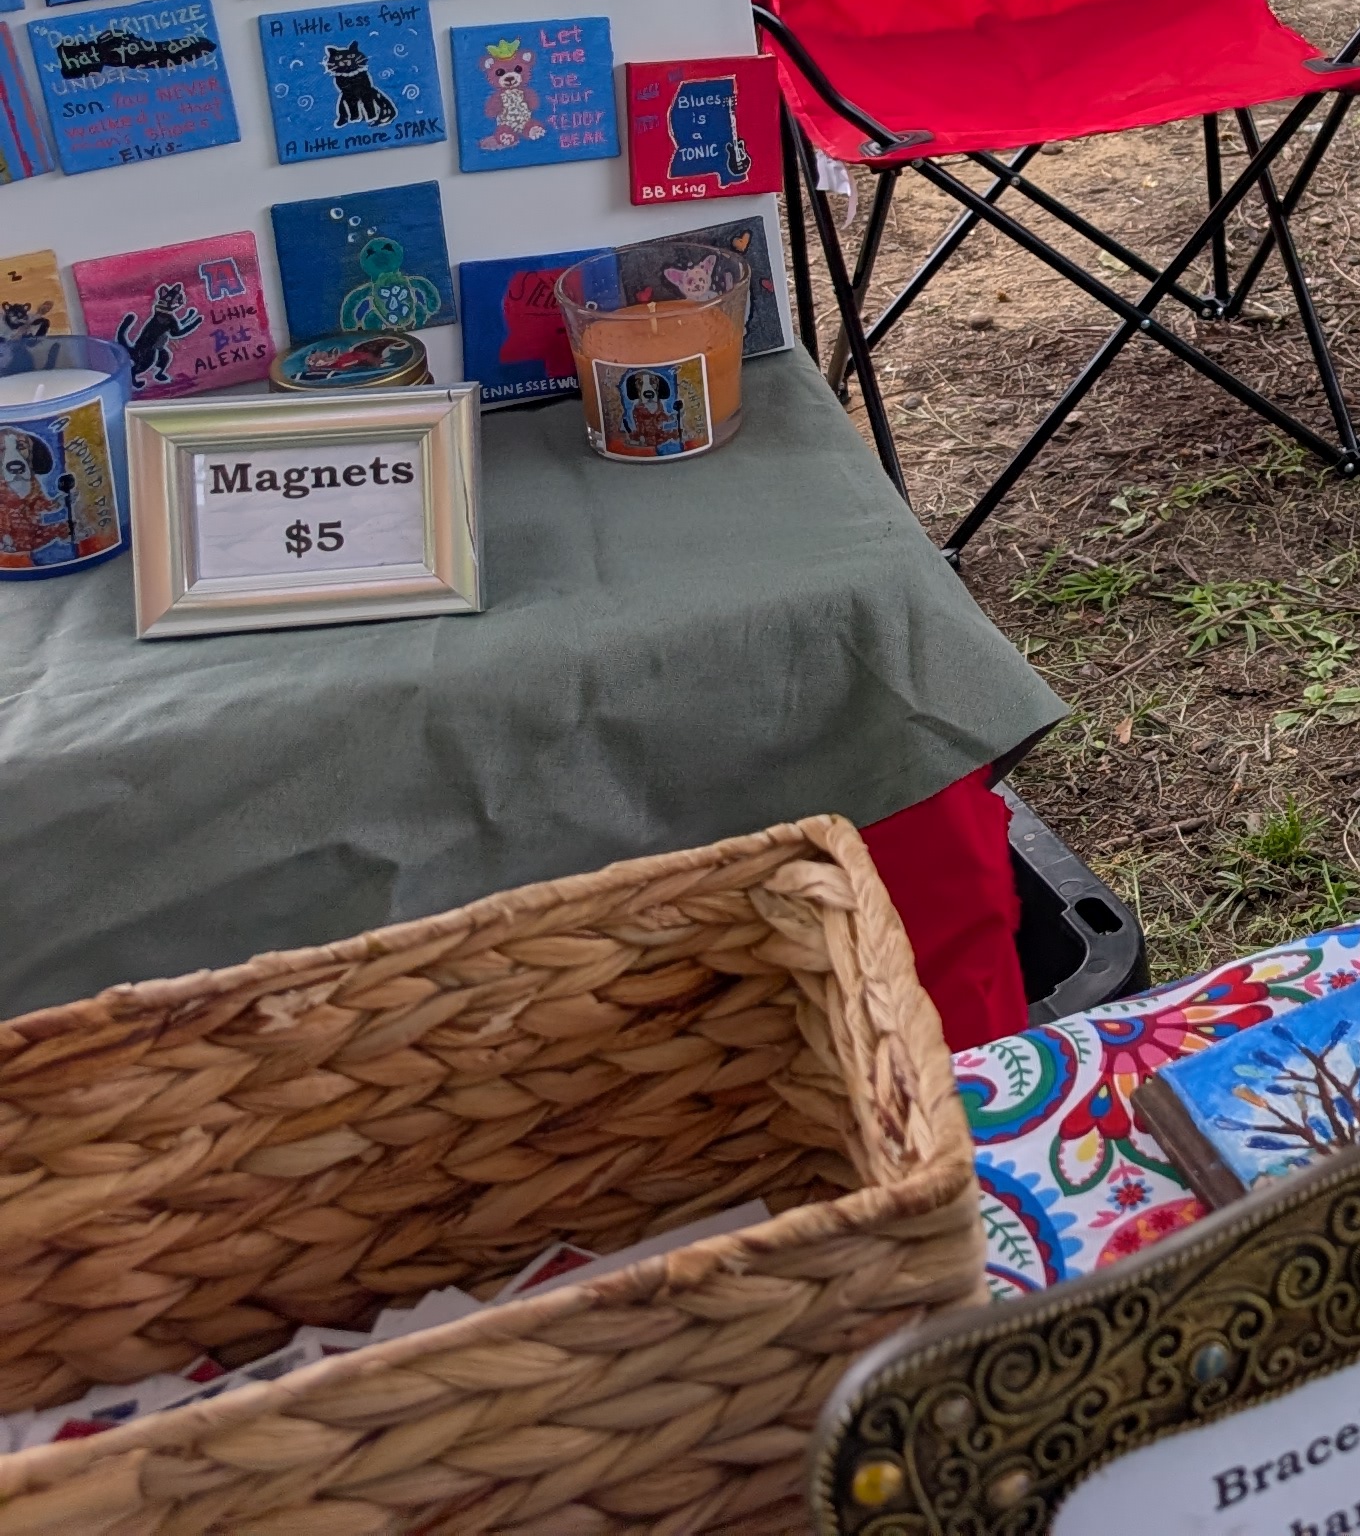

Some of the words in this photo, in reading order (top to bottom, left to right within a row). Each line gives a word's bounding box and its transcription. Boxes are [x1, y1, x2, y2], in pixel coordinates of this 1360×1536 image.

[270, 20, 283, 37] A
[293, 18, 332, 35] little
[339, 13, 371, 31] less
[378, 5, 421, 25] fight
[540, 25, 583, 48] Let
[112, 37, 158, 63] you
[551, 48, 586, 64] me
[157, 77, 223, 101] NEVER
[549, 73, 582, 88] be
[545, 89, 594, 113] your
[678, 95, 721, 109] Blues
[692, 112, 707, 125] is
[286, 141, 297, 156] A
[305, 137, 340, 153] little
[345, 132, 391, 149] more
[394, 117, 444, 139] SPARK
[692, 132, 703, 140] a
[679, 144, 719, 161] TONIC
[642, 186, 666, 200] BB
[672, 183, 706, 198] King
[200, 258, 246, 301] A
[210, 304, 258, 325] Little
[209, 325, 252, 352] Bit
[195, 344, 268, 375] ALEXIS
[49, 416, 70, 432] A
[66, 437, 103, 488] HOUND
[209, 456, 414, 499] Magnets
[285, 519, 345, 558] $5
